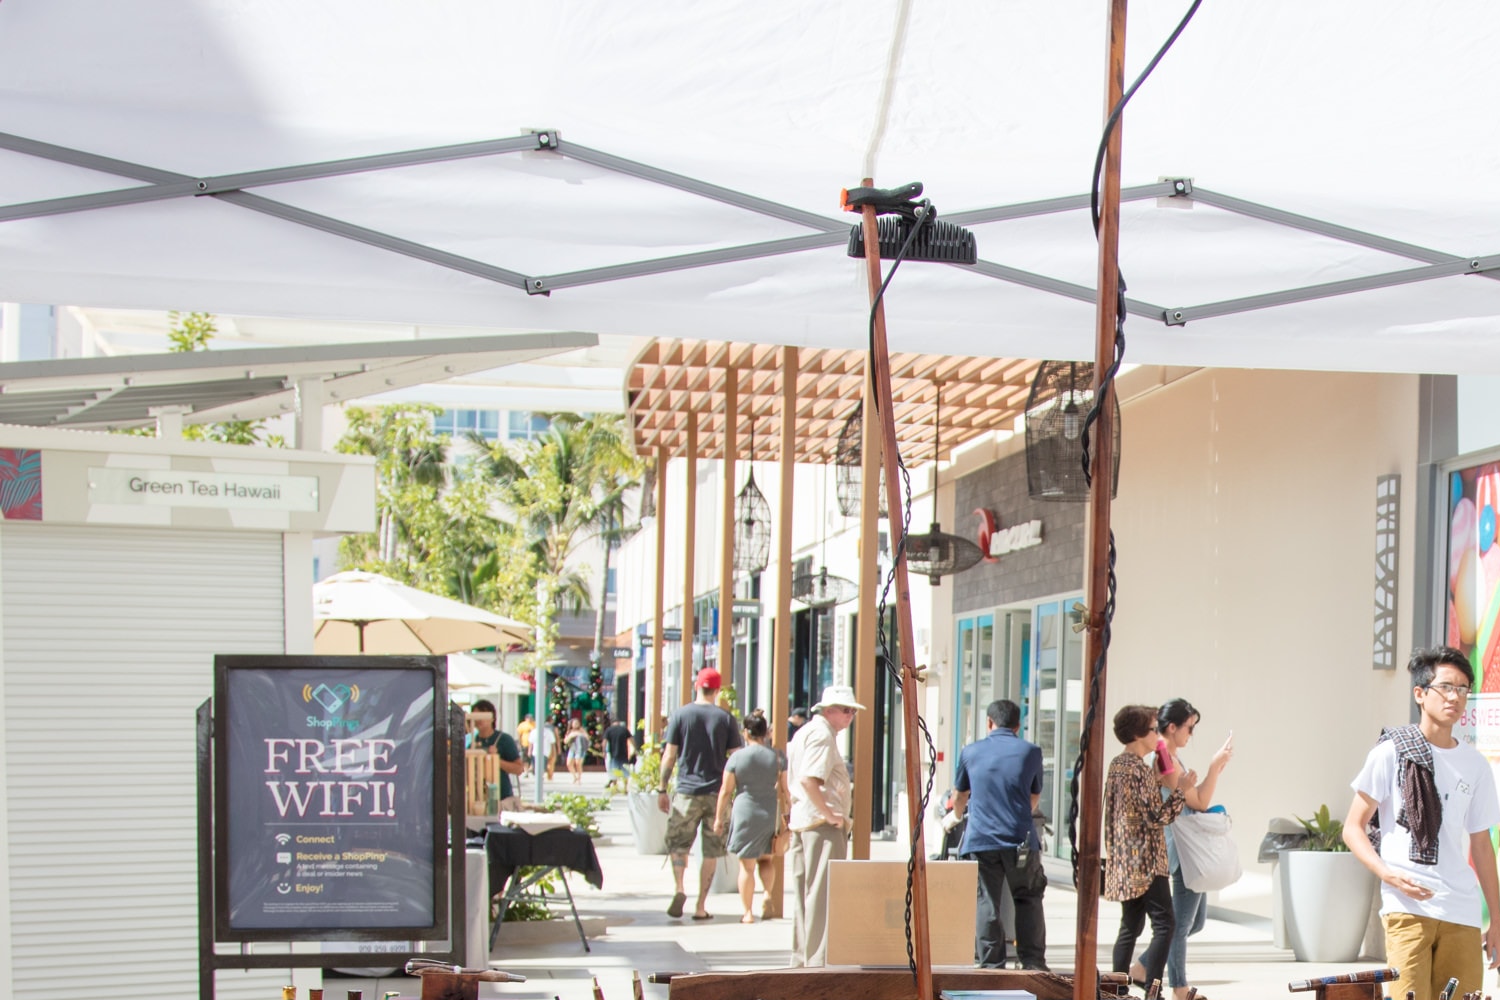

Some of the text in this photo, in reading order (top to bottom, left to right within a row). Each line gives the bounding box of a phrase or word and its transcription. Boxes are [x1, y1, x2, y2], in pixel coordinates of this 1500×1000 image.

[129, 477, 282, 499] Green Tea Hawaii
[264, 738, 398, 774] FREE
[265, 781, 396, 818] WIFI!
[296, 835, 335, 844] Connect
[296, 852, 333, 861] Receive
[296, 884, 324, 894] Enjoy!
